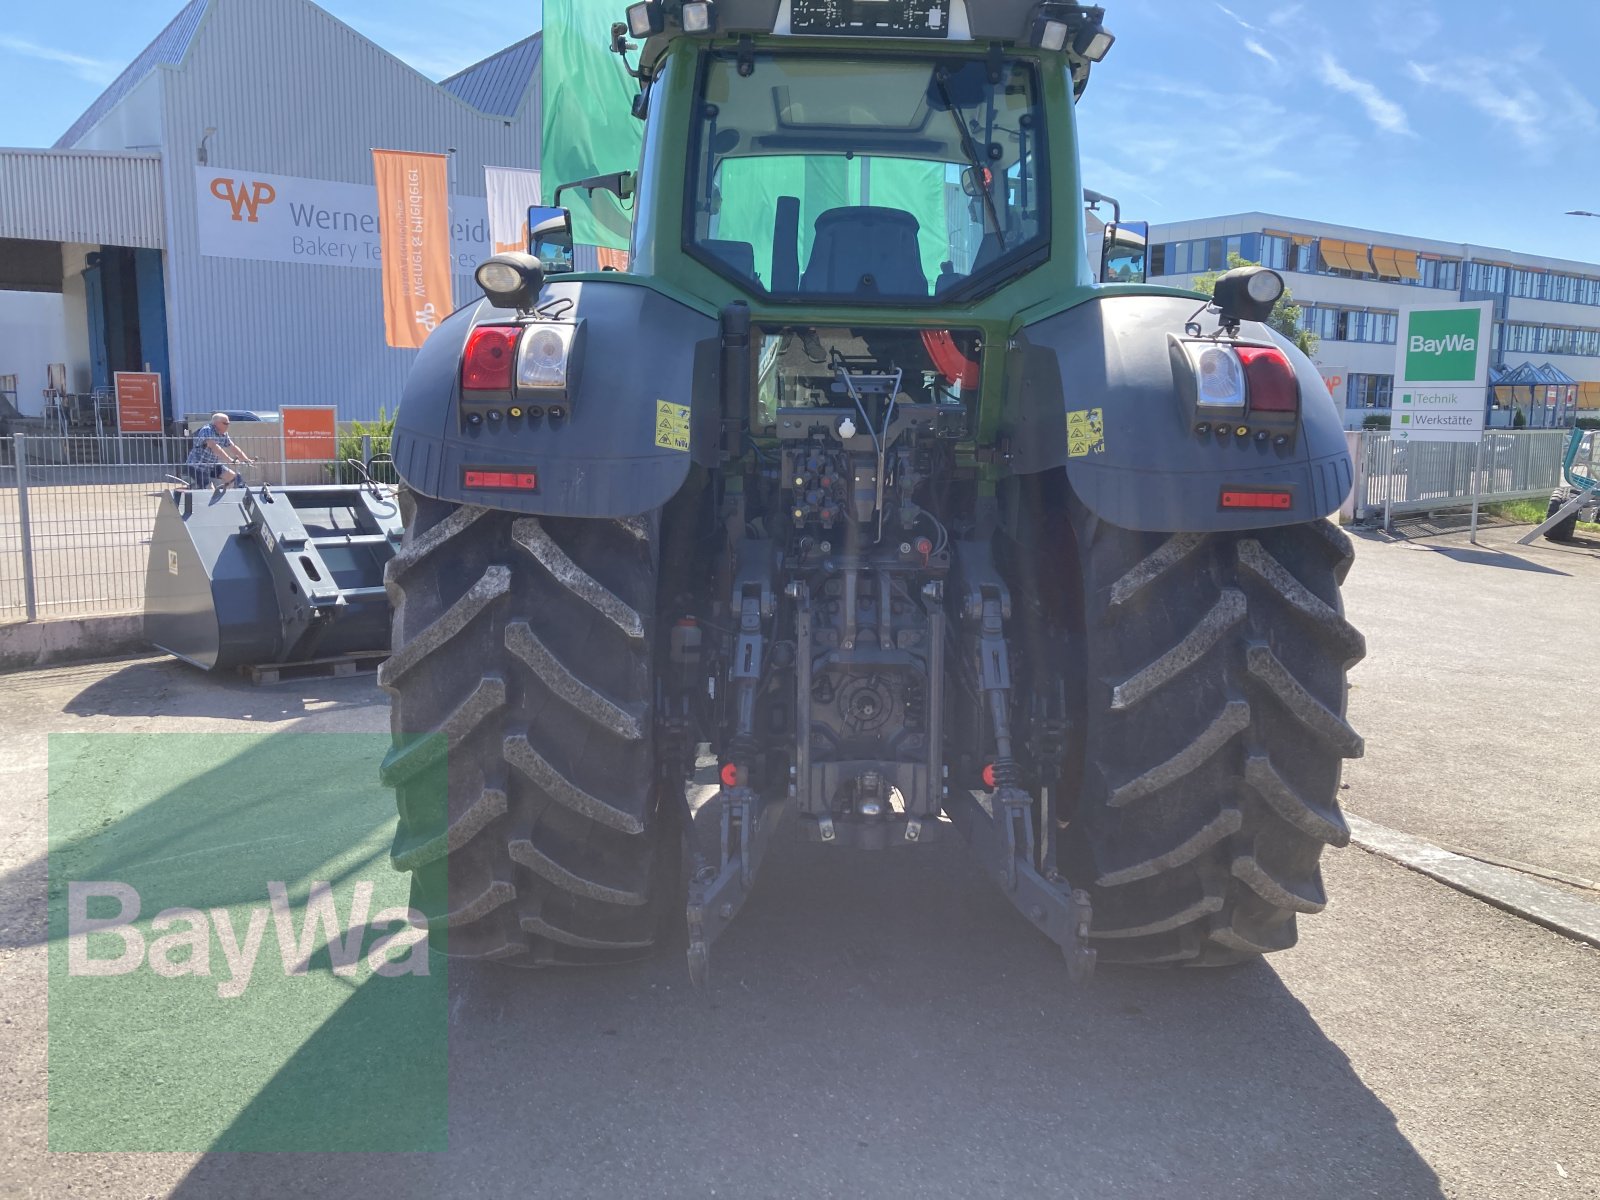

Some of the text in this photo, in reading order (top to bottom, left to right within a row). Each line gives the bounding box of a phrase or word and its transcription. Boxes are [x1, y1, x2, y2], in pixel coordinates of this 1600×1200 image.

[292, 235, 477, 268] Bakery Te es
[1410, 334, 1475, 355] BayWa
[1416, 393, 1458, 404] Technik
[1415, 414, 1473, 426] Werkstätte
